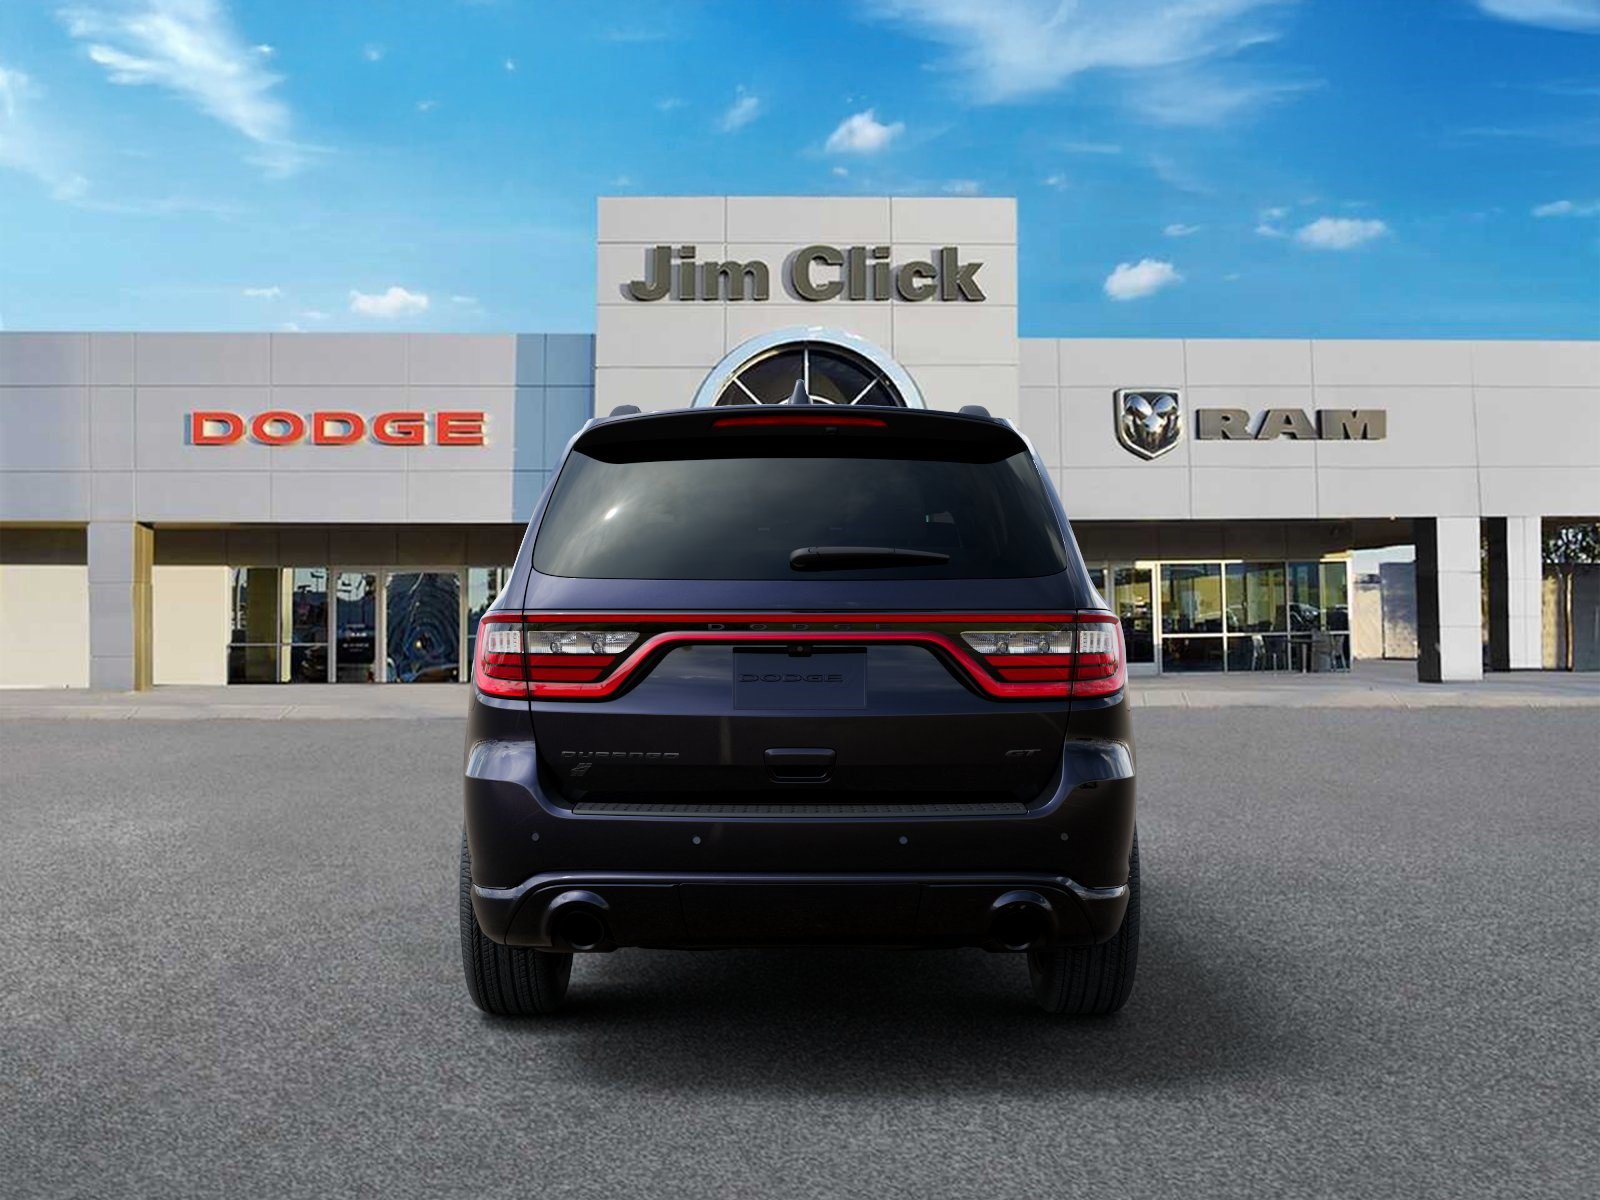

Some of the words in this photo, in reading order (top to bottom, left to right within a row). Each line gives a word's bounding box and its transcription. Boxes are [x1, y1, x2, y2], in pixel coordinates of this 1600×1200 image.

[627, 245, 770, 301] Jim
[789, 244, 986, 302] Click
[190, 410, 486, 446] DODGE
[1196, 408, 1387, 440] RAM
[707, 623, 893, 631] DODGE
[738, 673, 844, 683] DODGE
